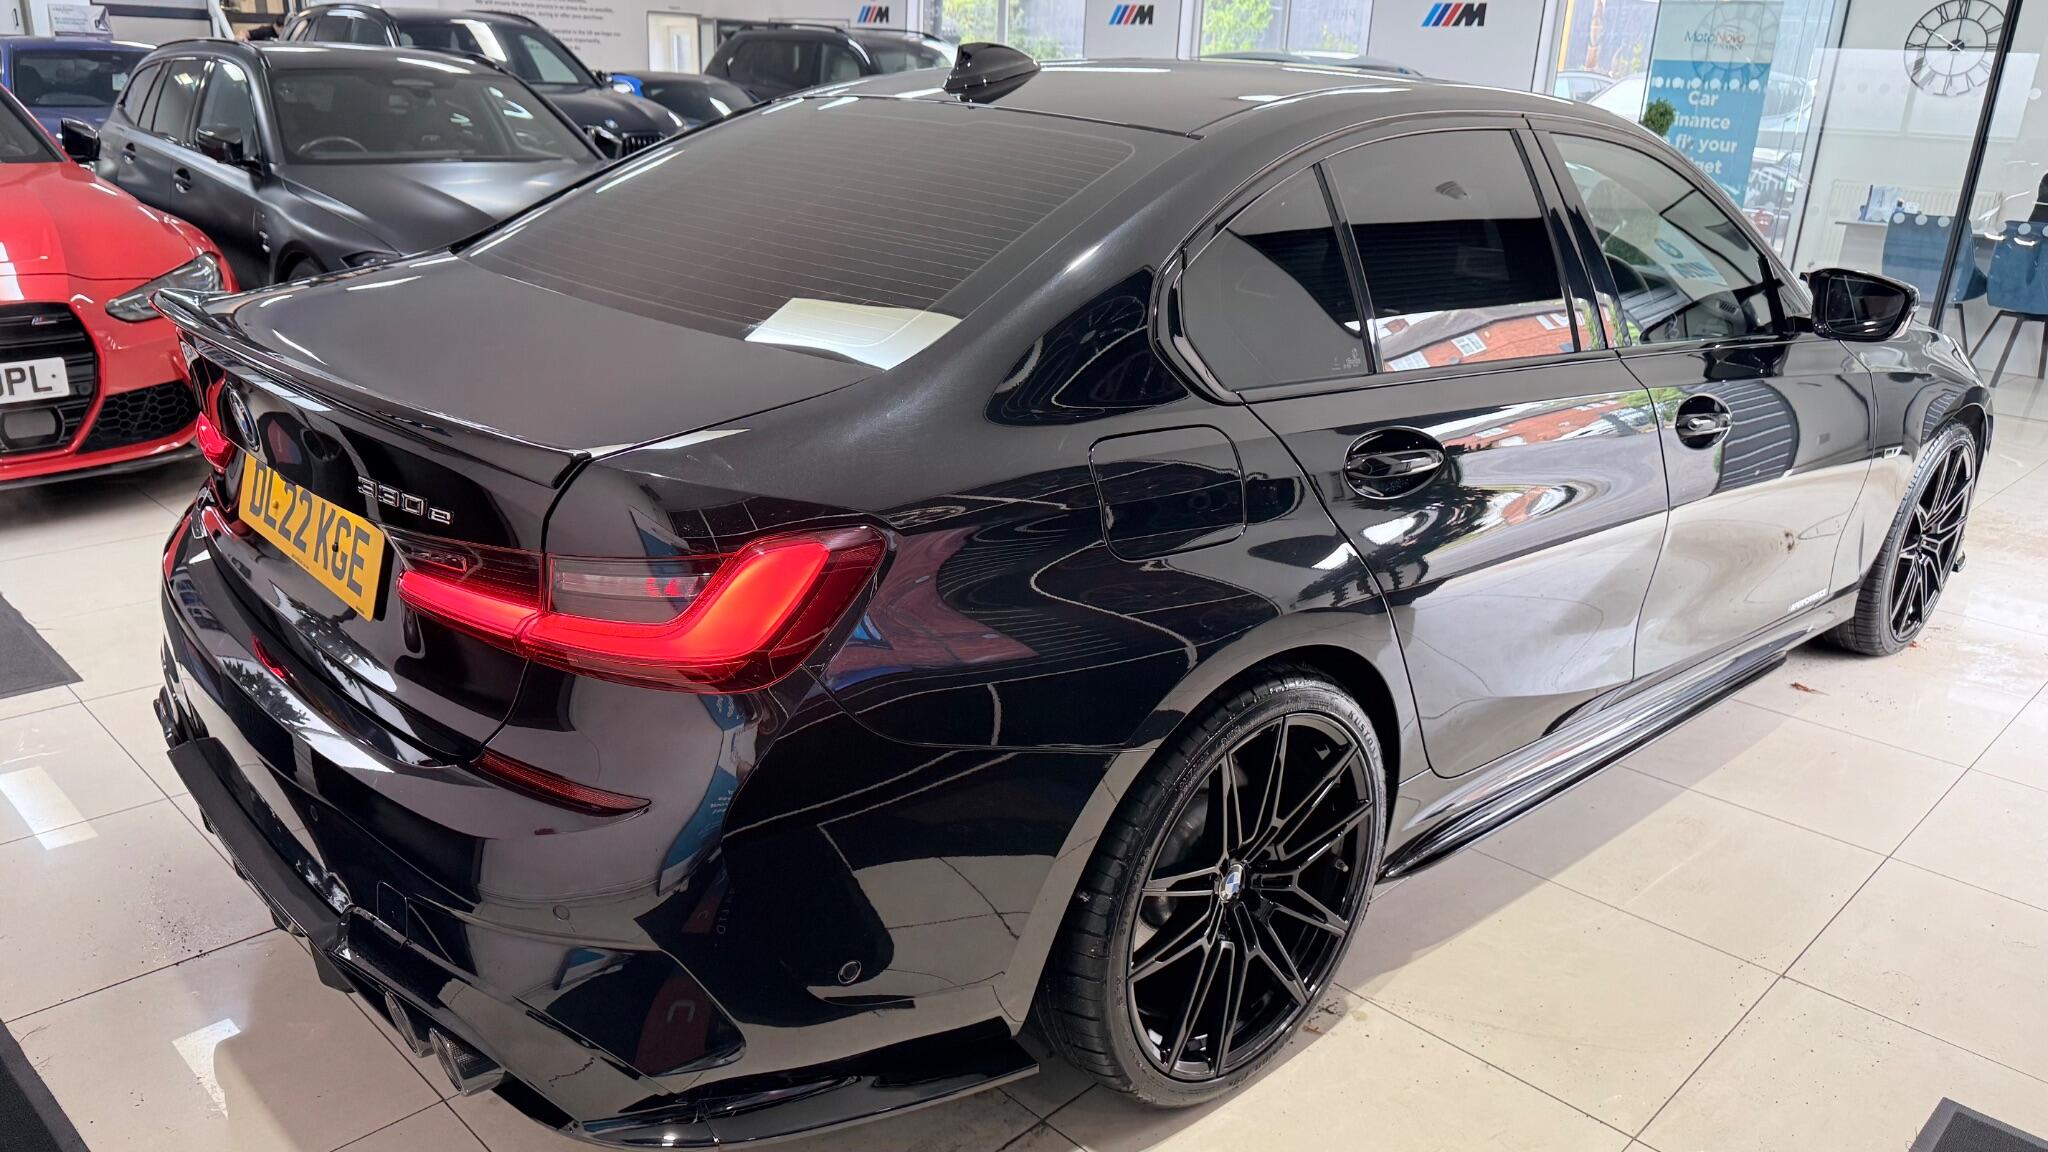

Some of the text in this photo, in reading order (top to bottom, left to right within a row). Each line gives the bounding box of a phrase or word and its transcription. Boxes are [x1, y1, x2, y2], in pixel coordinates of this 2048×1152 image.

[1688, 90, 1719, 106] Car
[1673, 111, 1731, 130] inance
[1697, 138, 1738, 153] your
[0, 365, 53, 398] PL
[357, 475, 455, 526] 330e
[249, 463, 371, 598] DL22 KGE
